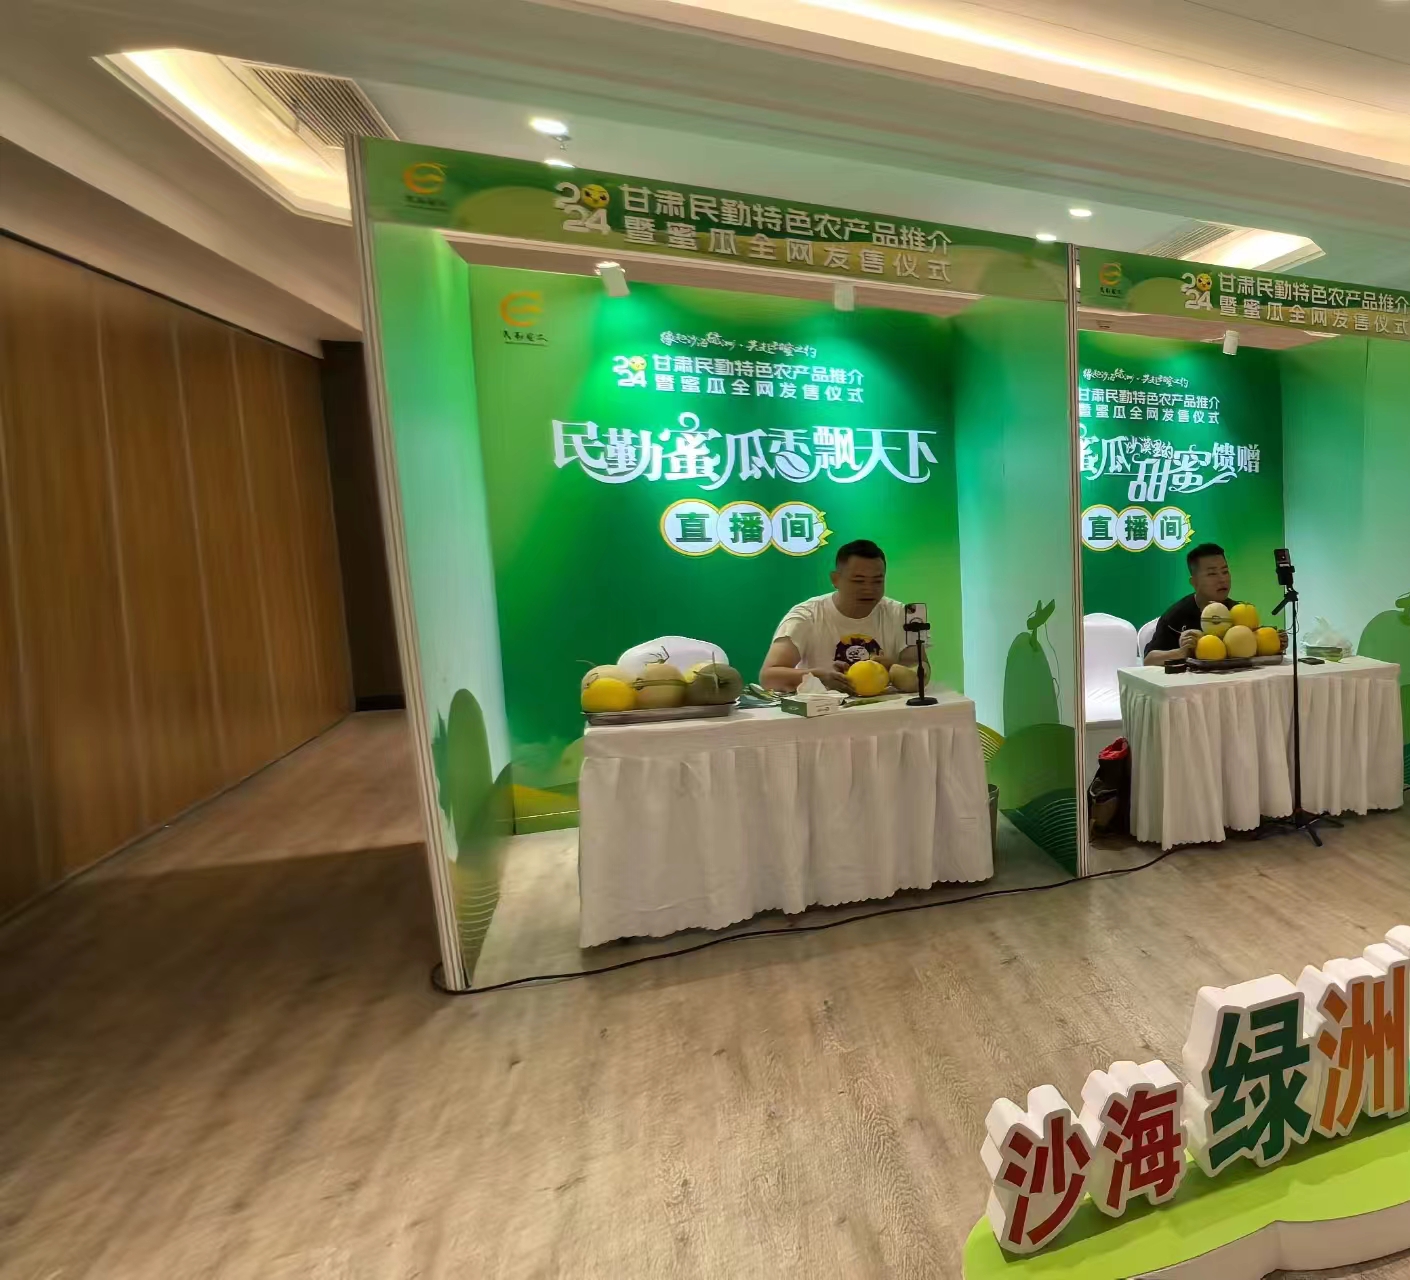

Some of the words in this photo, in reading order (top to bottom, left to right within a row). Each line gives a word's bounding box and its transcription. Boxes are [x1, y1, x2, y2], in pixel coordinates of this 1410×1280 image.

[619, 183, 952, 255] 甘肃民勤特色农产品推介
[624, 215, 951, 283] 暨蜜瓜全网发售仪式
[1218, 271, 1410, 316] 甘肃民勤特色农产品推介
[1219, 294, 1409, 336] 暨蜜瓜全网发售仪式
[652, 354, 864, 386] 甘肃民勤特色农产品推介
[655, 373, 864, 403] 暨蜜瓜全网发售仪式
[552, 412, 939, 491] 民勤蜜瓜香飘天下
[675, 511, 815, 545] 直播间
[1088, 514, 1183, 542] 直播间
[1003, 966, 1408, 1246] 沙海绿洲
